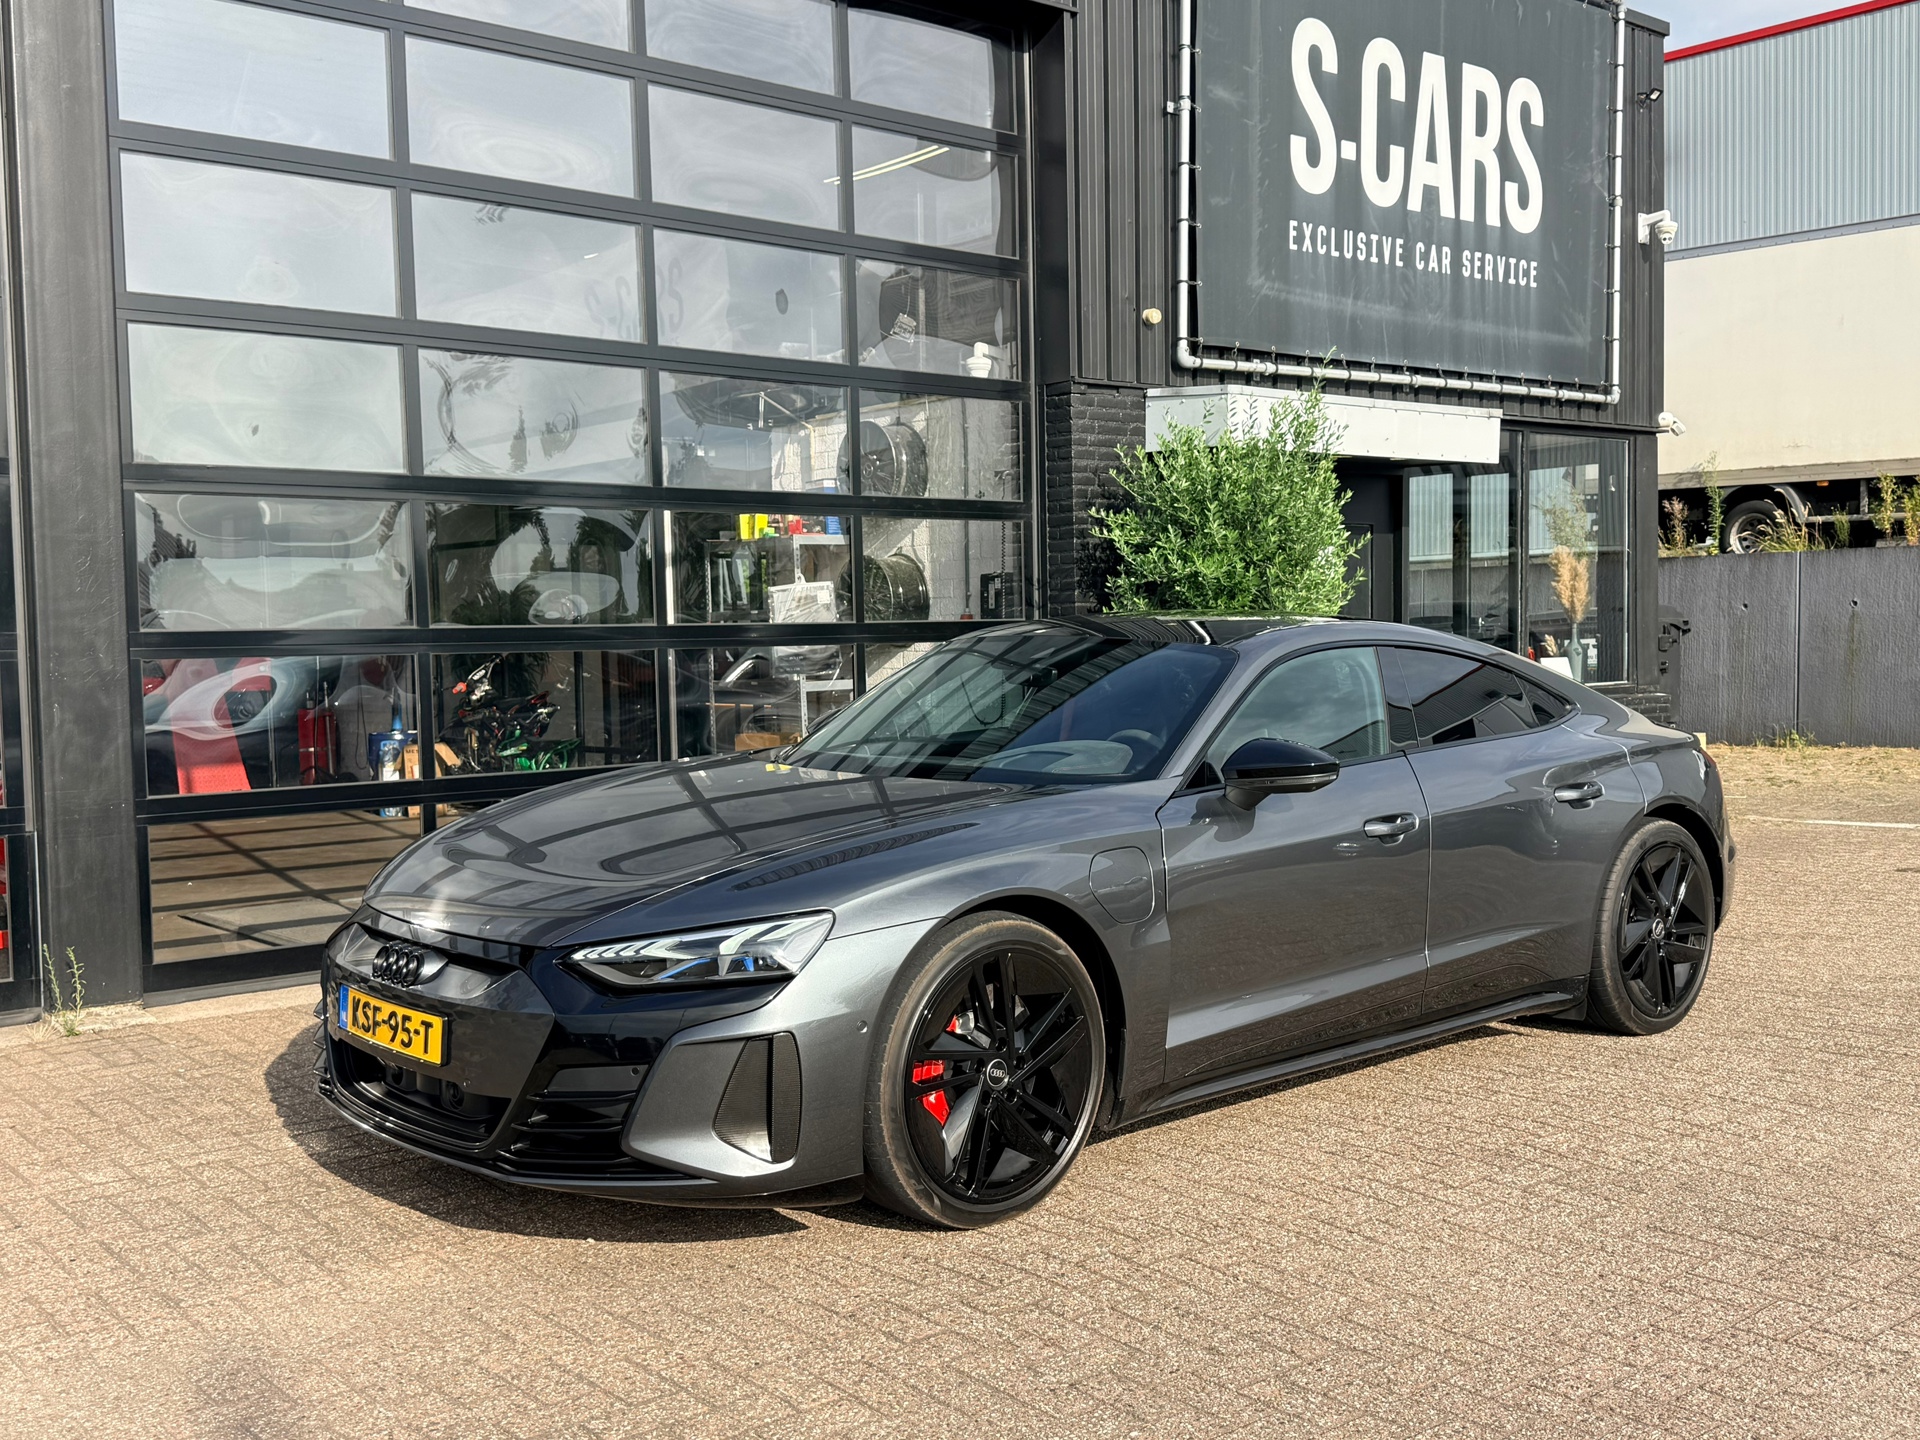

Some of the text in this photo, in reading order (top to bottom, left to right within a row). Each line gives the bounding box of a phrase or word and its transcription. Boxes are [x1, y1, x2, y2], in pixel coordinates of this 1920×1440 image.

[1290, 17, 1544, 234] S-CARS
[1289, 220, 1538, 288] EXCLUSIVE CAR SERVICE
[352, 995, 434, 1055] KSF-95-T
